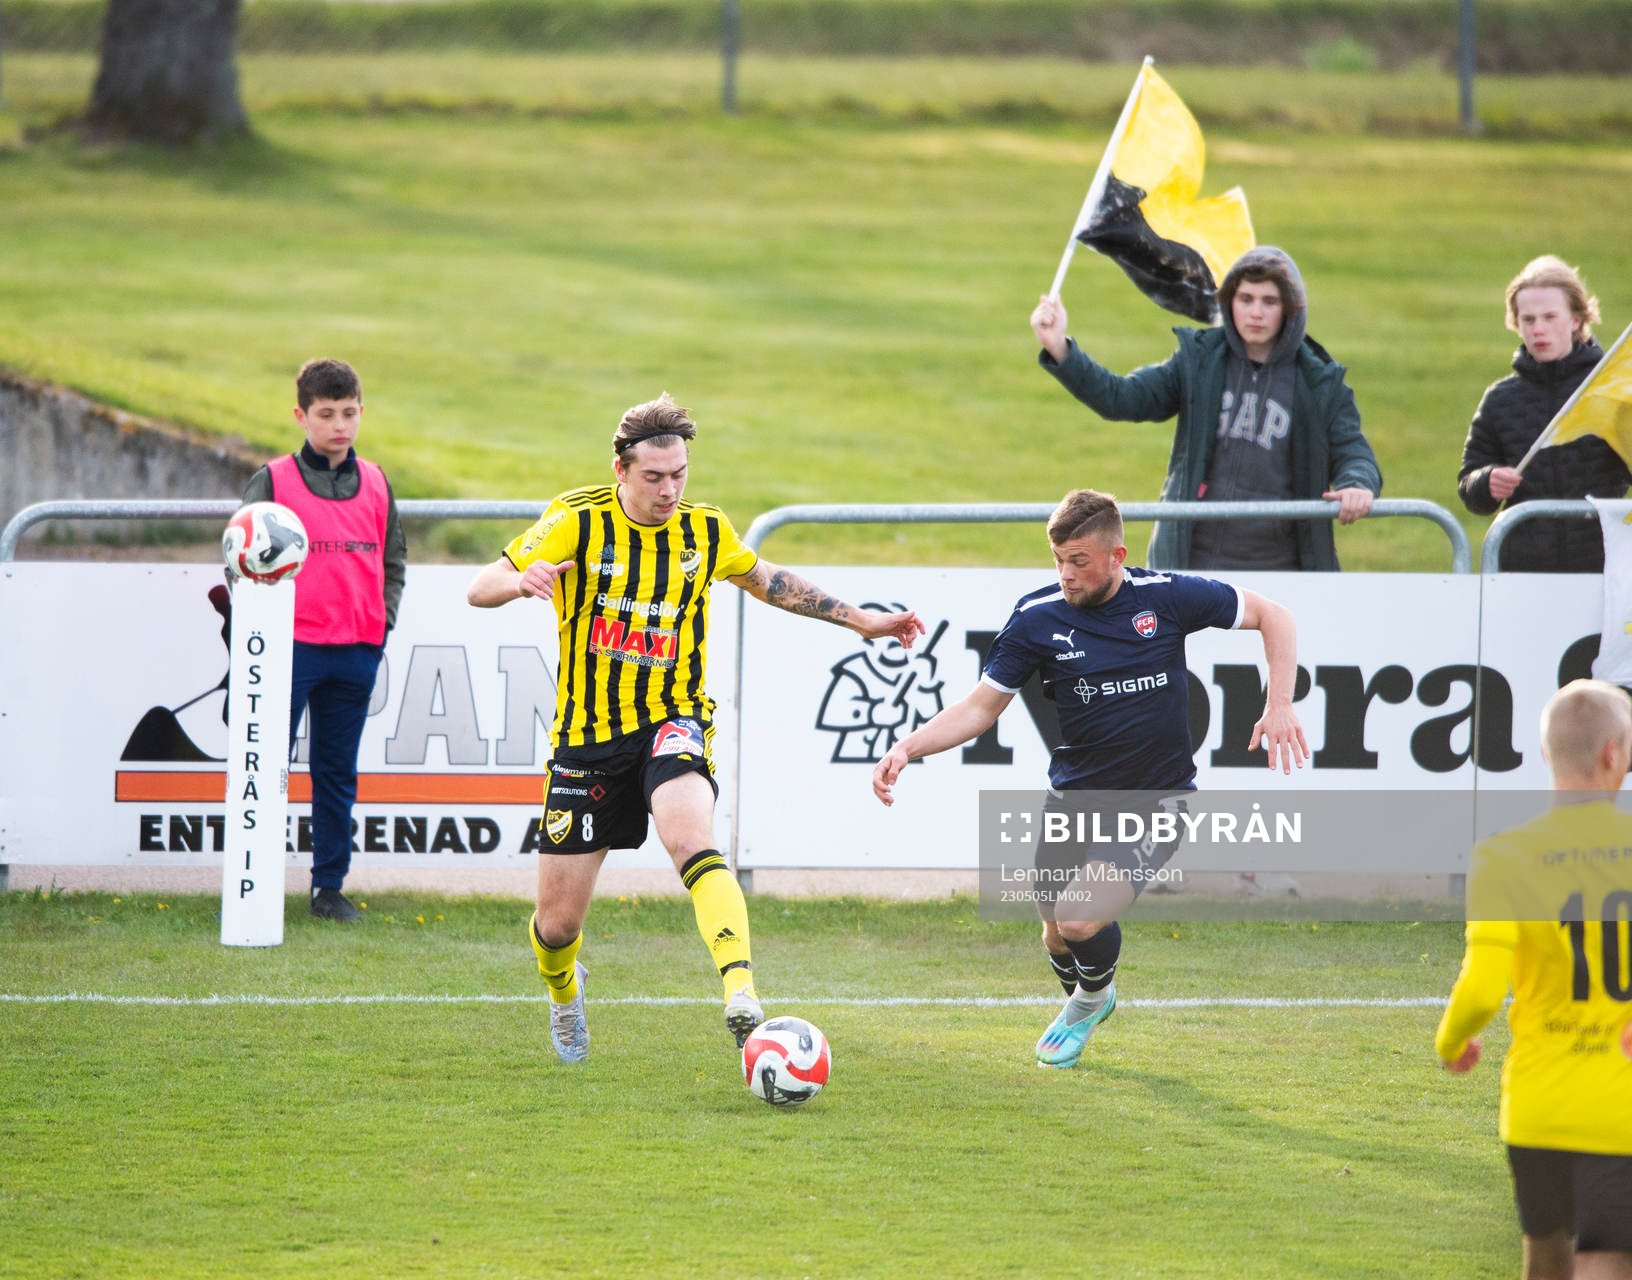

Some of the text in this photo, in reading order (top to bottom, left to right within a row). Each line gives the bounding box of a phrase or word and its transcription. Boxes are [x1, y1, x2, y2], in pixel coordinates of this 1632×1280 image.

[308, 541, 378, 554] NTERSPORT
[596, 592, 681, 618] Ballingslöv
[1136, 616, 1155, 628] FCR
[590, 615, 678, 660] MAXI
[582, 812, 594, 842] 8
[1558, 889, 1632, 1003] 10
